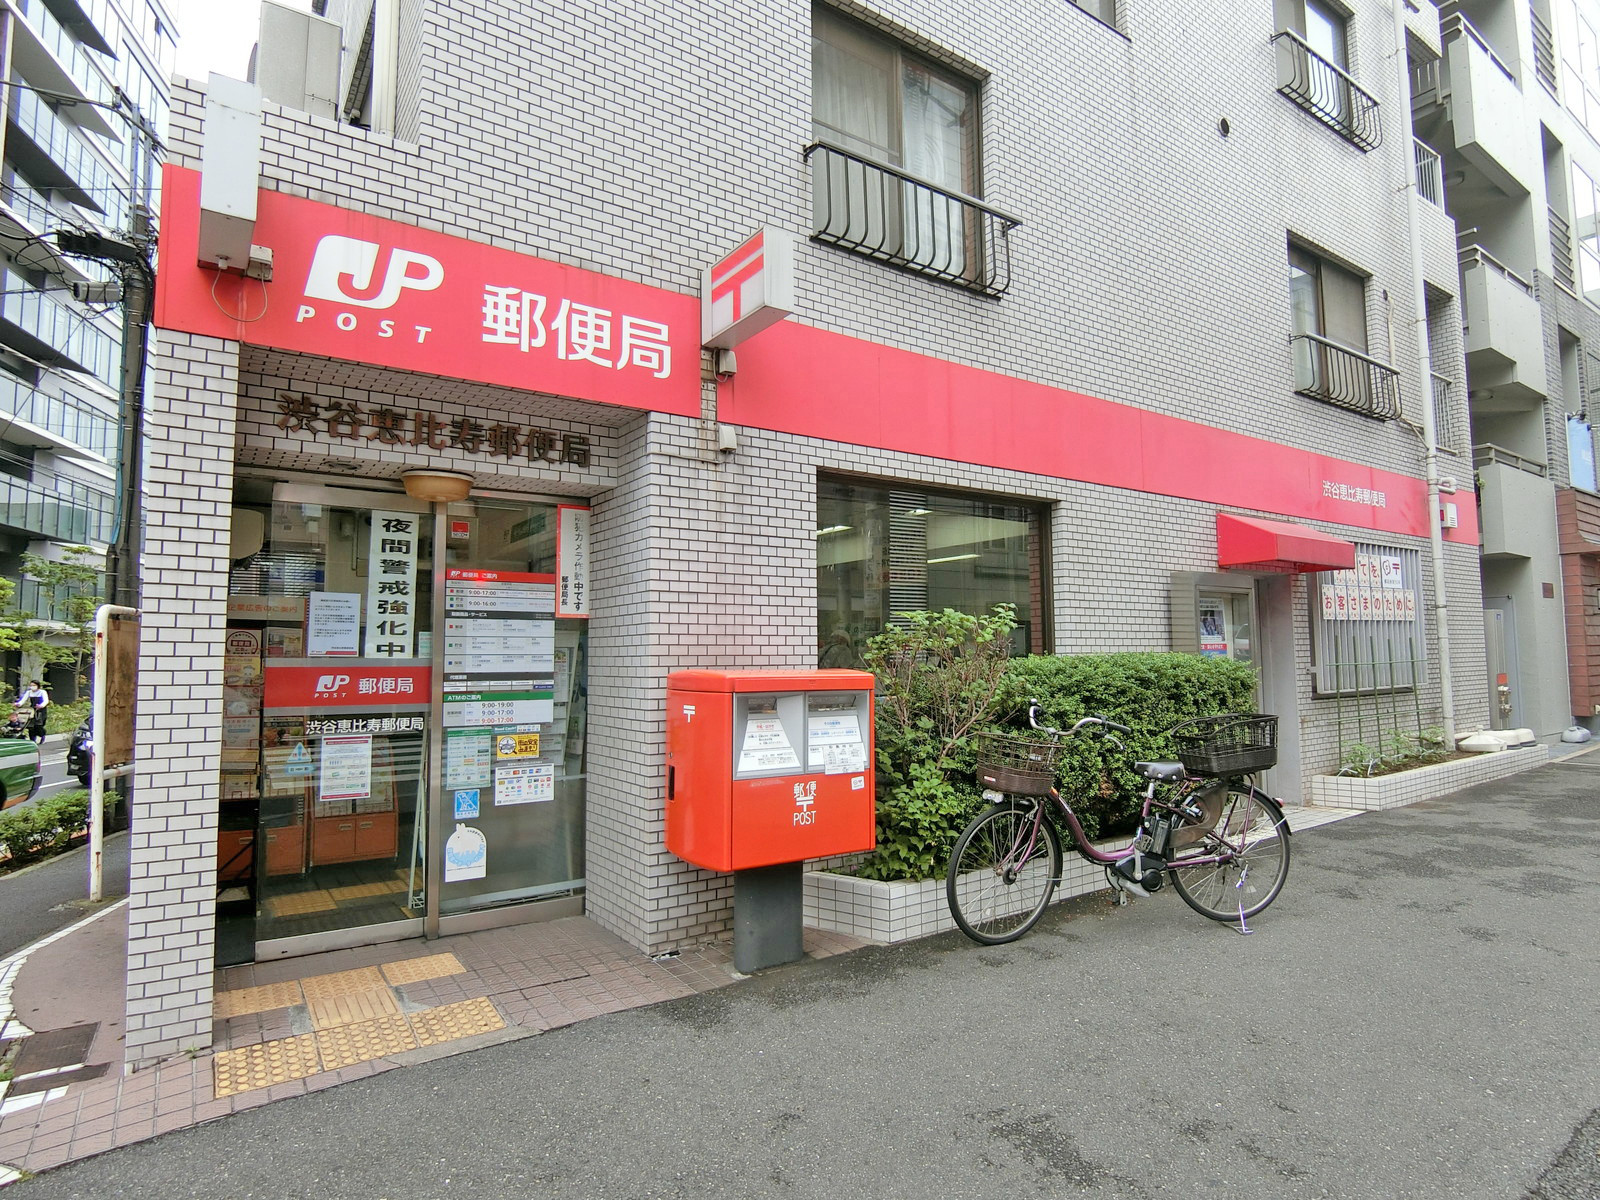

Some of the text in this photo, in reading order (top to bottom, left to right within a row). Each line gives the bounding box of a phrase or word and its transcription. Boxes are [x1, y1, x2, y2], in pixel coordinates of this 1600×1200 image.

[304, 235, 444, 310] JP
[296, 304, 432, 344] POST
[482, 283, 672, 379] 郵便局
[277, 394, 591, 468] 渋谷恵比寿郵便局
[1322, 480, 1386, 508] 渋谷恵比寿郵便局
[376, 518, 413, 657] 夜間警戒強化中
[561, 576, 569, 606] 郵便局長
[1325, 595, 1414, 611] お客さまのために。
[358, 677, 414, 695] 郵便局
[306, 717, 424, 736] 渋谷恵比寿郵便局
[481, 716, 514, 724] 9:00-17:00
[793, 780, 817, 799] 郵便
[793, 810, 817, 826] POST
